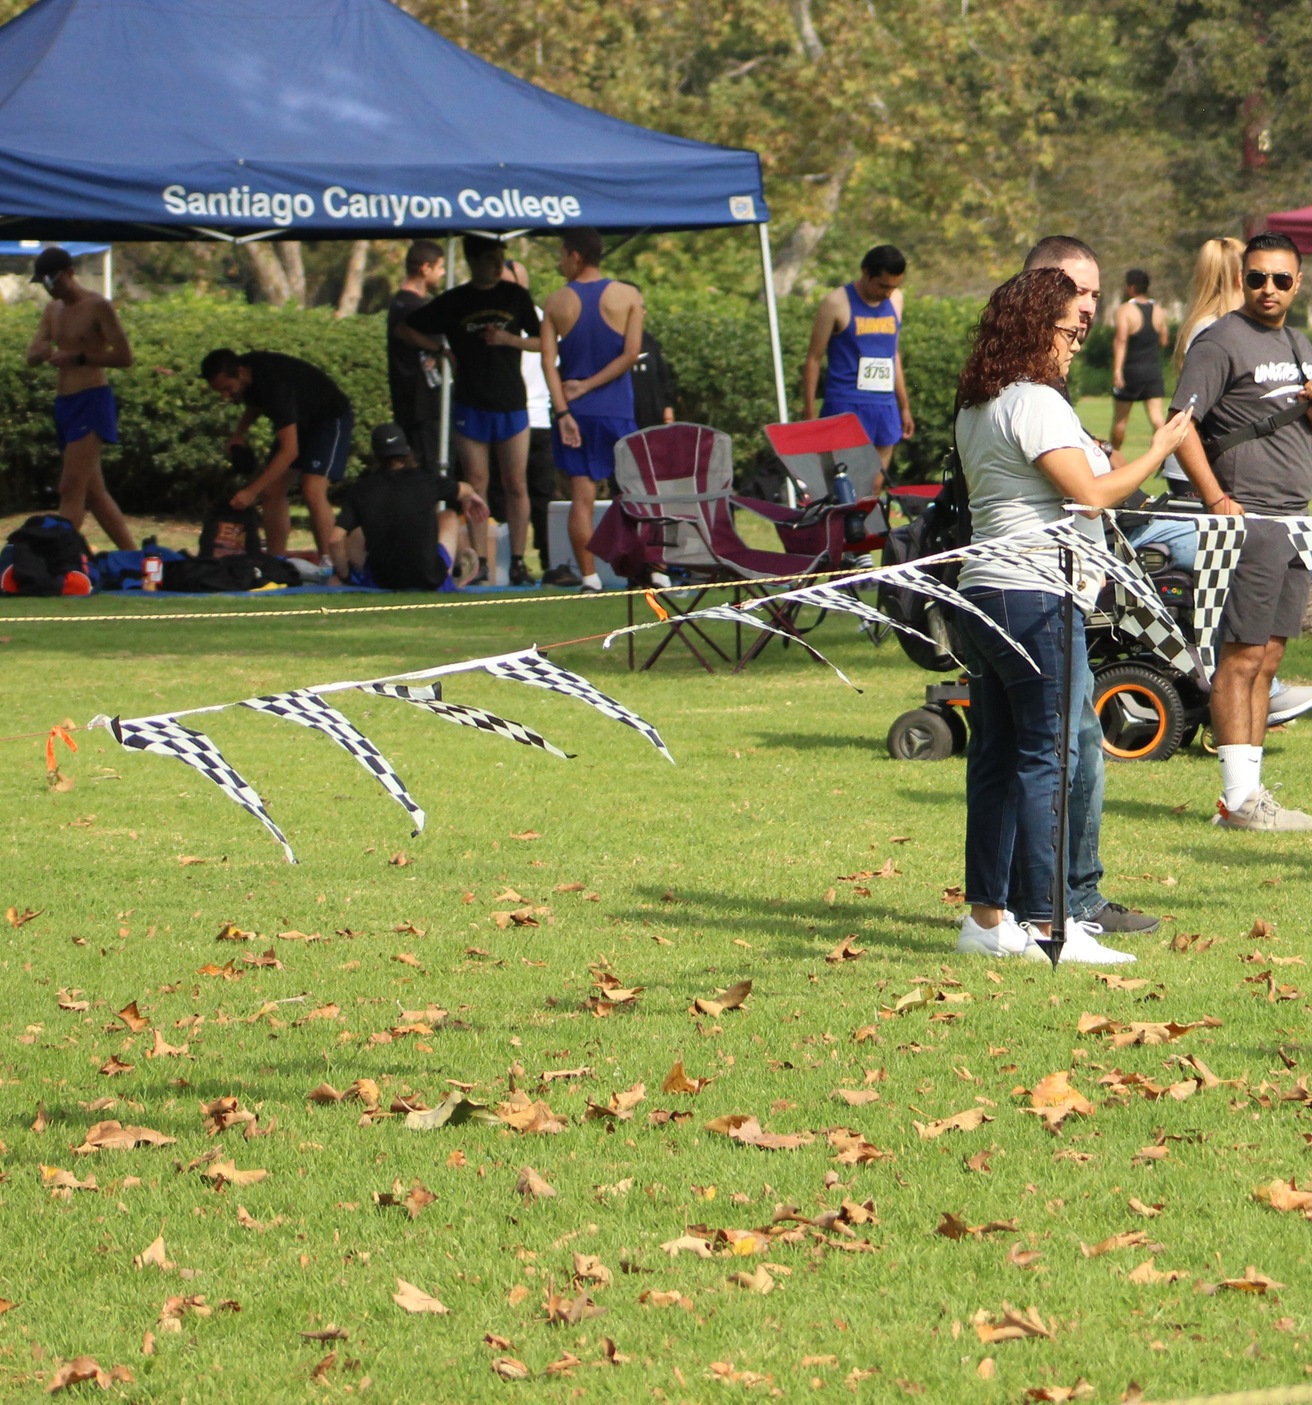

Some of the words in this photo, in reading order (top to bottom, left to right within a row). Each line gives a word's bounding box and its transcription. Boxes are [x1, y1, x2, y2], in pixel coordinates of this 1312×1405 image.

[162, 185, 315, 226] Santiago
[323, 186, 452, 226] Canyon
[458, 188, 582, 225] College
[864, 365, 890, 380] 3753
